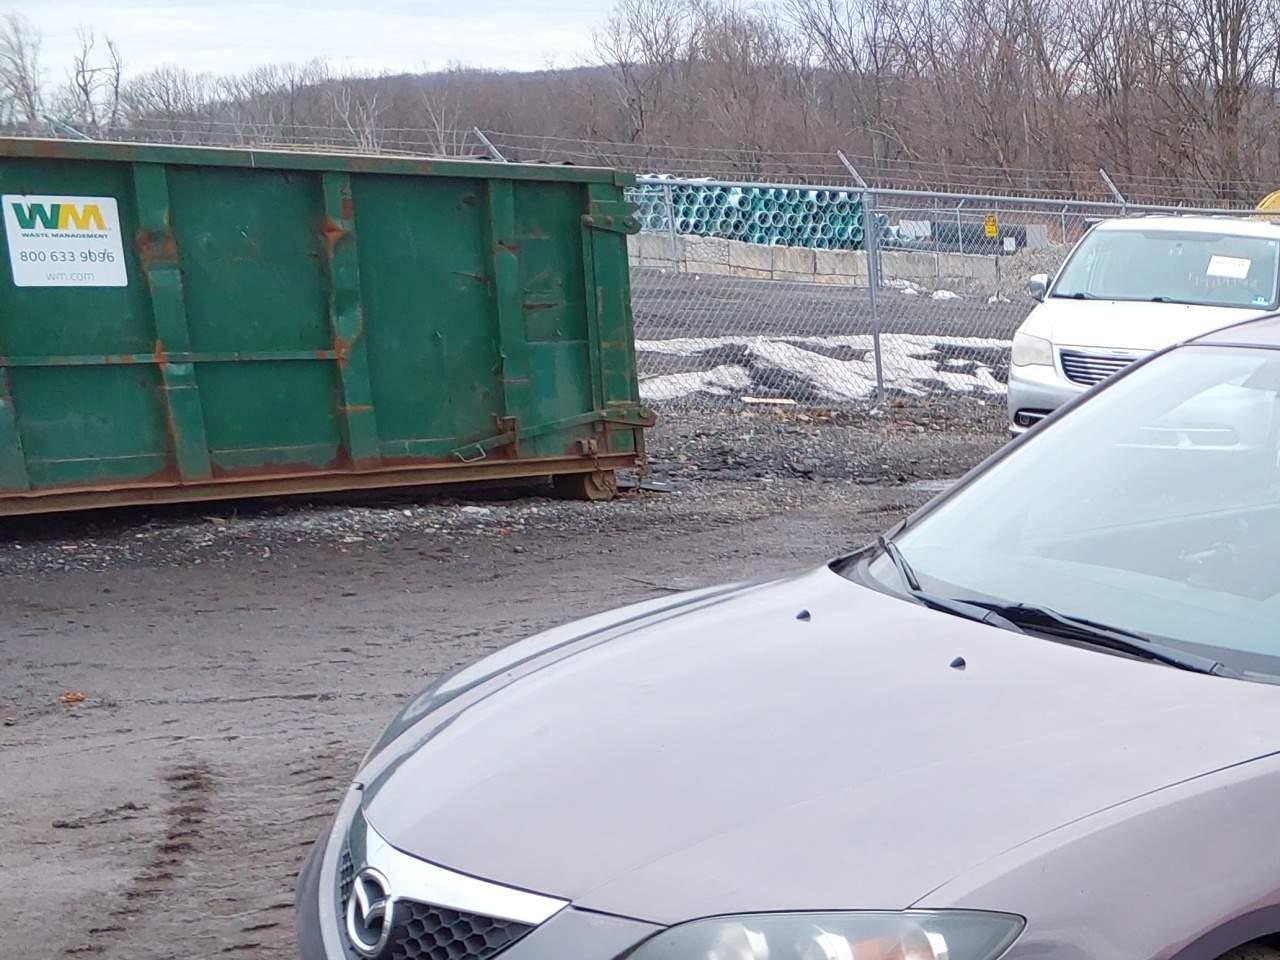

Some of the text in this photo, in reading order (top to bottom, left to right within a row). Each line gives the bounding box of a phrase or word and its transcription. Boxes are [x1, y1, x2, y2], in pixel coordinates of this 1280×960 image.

[11, 203, 107, 230] WM
[20, 251, 46, 262] 800
[50, 251, 76, 262] 633
[46, 272, 96, 281] wm.com
